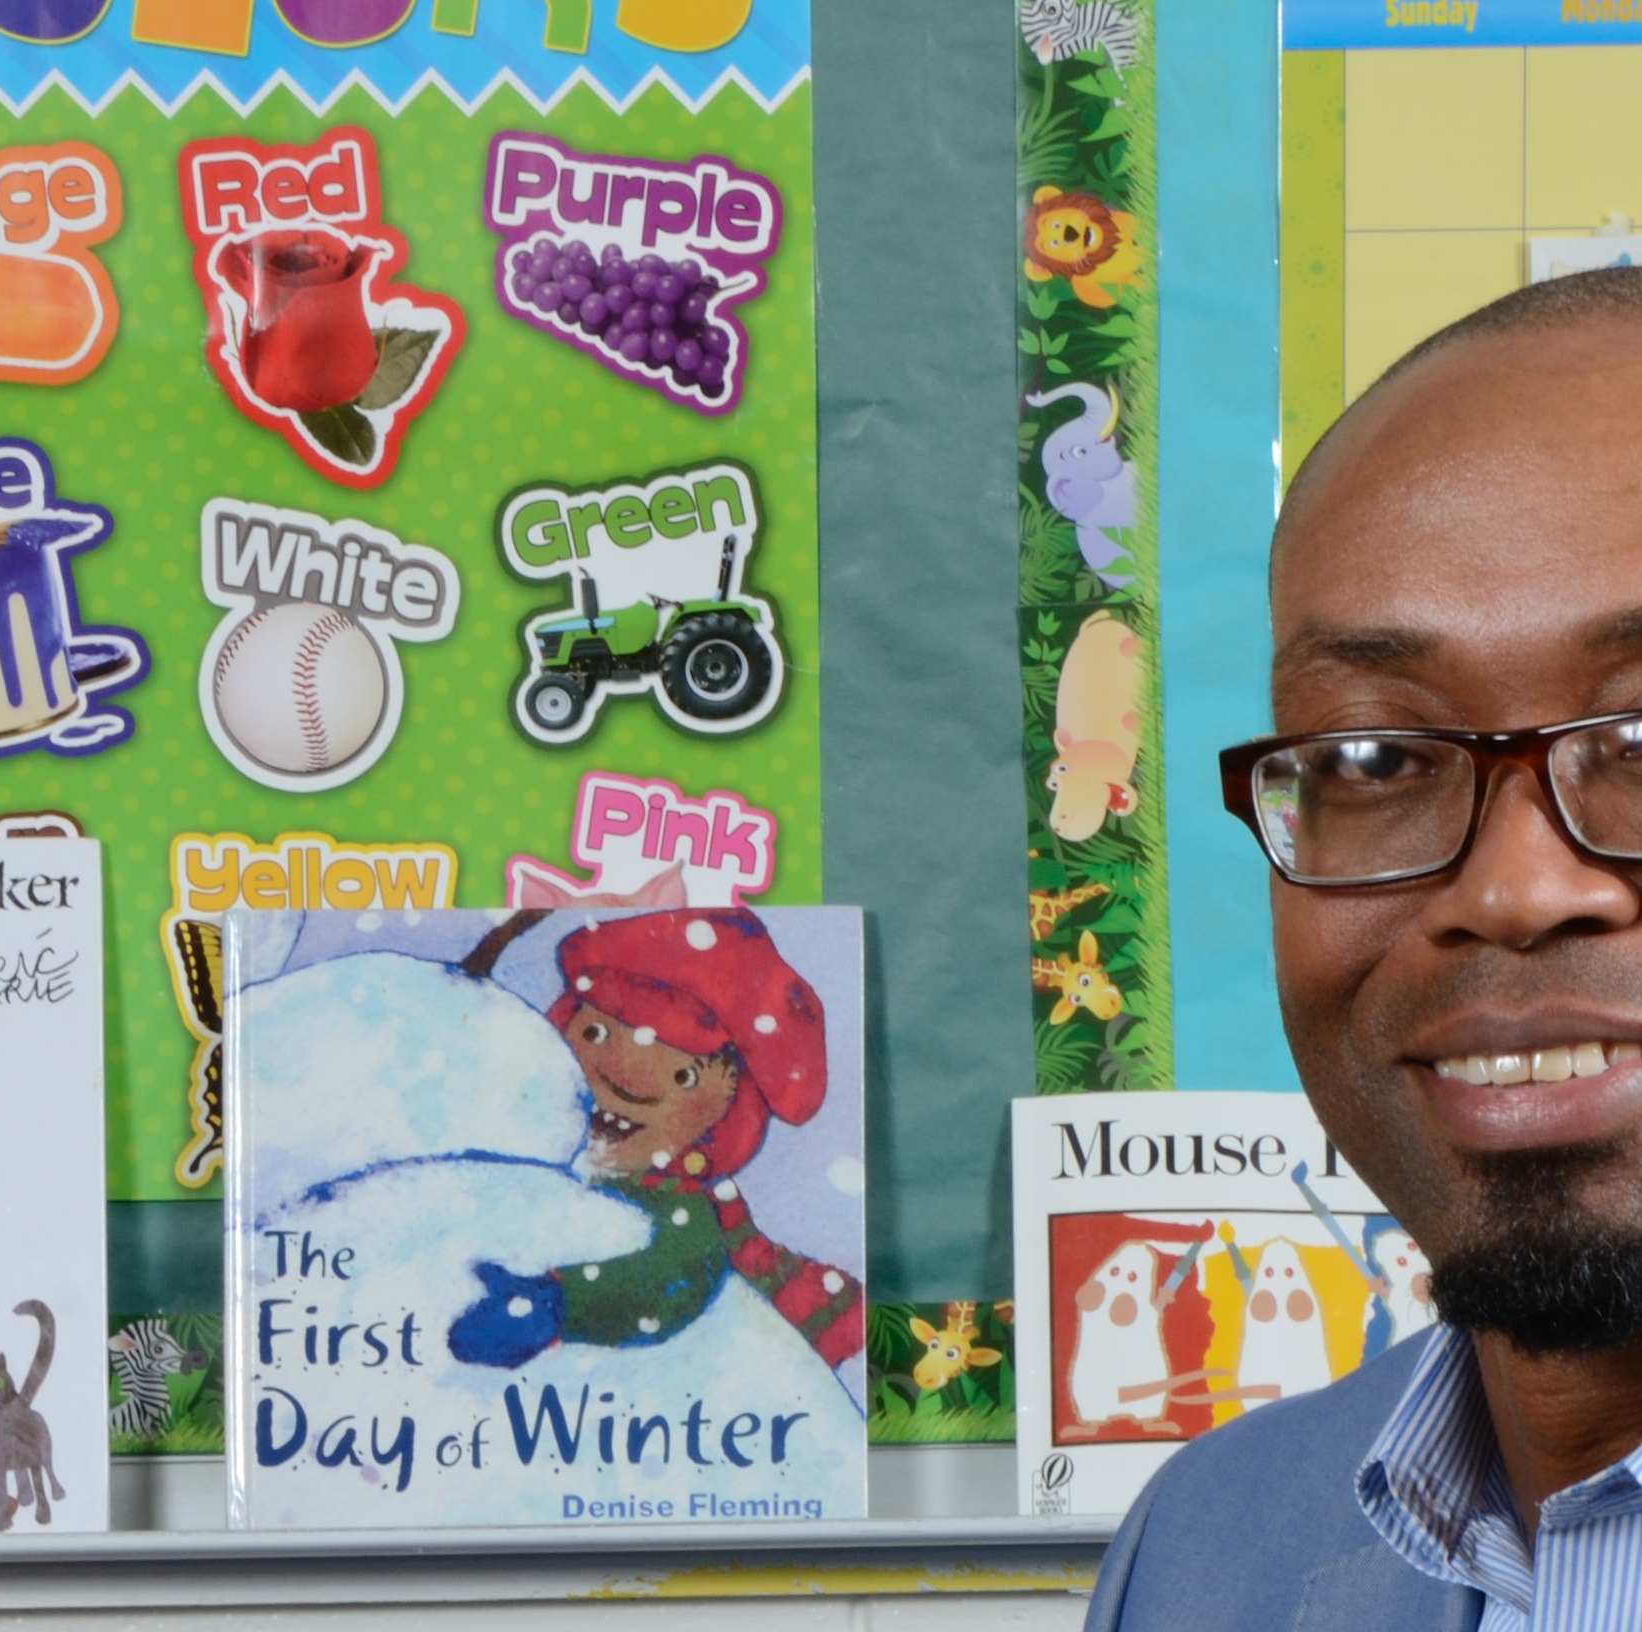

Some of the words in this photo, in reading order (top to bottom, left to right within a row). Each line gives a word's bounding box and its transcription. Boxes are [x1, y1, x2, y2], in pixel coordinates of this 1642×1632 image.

[199, 149, 361, 226] Red
[499, 148, 763, 245] Purple
[509, 473, 746, 568] Green
[217, 519, 447, 623] White
[586, 785, 769, 872] Pink
[185, 847, 441, 911] Yellow
[1051, 1119, 1286, 1180] Mouse
[264, 1230, 355, 1280] The
[258, 1299, 422, 1367] First
[256, 1387, 415, 1492] Day
[436, 1418, 490, 1469] of
[504, 1384, 809, 1473] Winter
[562, 1494, 674, 1519] Denise
[689, 1493, 823, 1519] Fleming
